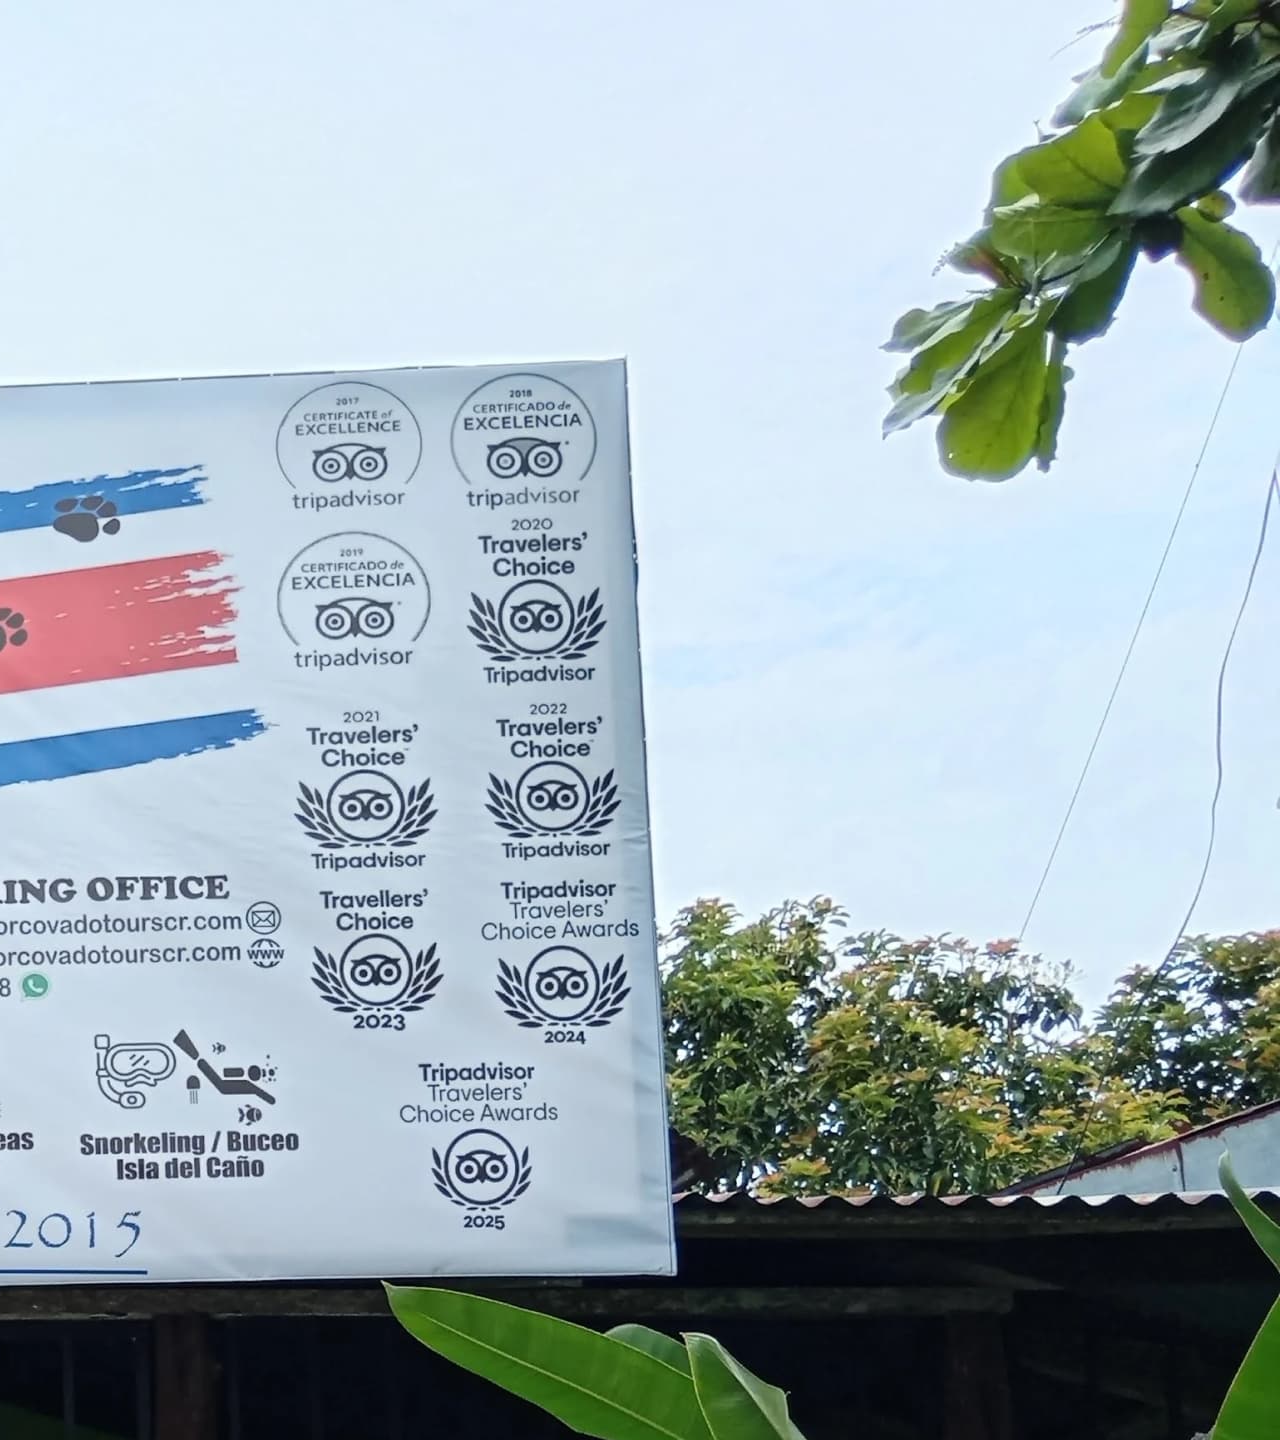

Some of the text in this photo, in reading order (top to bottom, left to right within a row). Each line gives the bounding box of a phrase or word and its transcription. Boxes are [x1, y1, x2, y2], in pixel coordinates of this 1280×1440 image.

[303, 409, 379, 422] CERTIFICATE
[472, 402, 555, 414] CERTIFICADO
[294, 419, 401, 436] EXCELLENCE
[463, 413, 583, 431] EXCELENCIA
[293, 489, 406, 512] tripadvisor
[466, 486, 580, 510] tripadvisor
[511, 518, 553, 531] 2020
[300, 560, 388, 573] CERTIFICADO
[492, 556, 575, 578] Choice
[291, 572, 416, 590] EXCELENCIA
[294, 647, 413, 671] tripadvisor
[483, 664, 595, 686] Tripadvisor
[343, 711, 380, 723] 2021
[529, 703, 568, 715] 2022
[321, 748, 406, 768] Choice
[510, 740, 591, 758] Choice
[501, 841, 611, 861] Tripadvisor
[311, 853, 426, 872] Tripadvisor
[87, 874, 230, 902] OFFICE
[500, 880, 616, 901] Tripadvisor
[335, 911, 414, 932] Choice
[480, 920, 640, 941] Choice Awards
[353, 1014, 406, 1030] 2023
[544, 1031, 586, 1044] 2024
[418, 1062, 535, 1085] Tripadvisor
[399, 1102, 559, 1124] Choice Awards
[80, 1130, 299, 1156] Snorkeling Buceo
[116, 1155, 265, 1181] Isla del Caño
[4, 1208, 141, 1257] 2015
[463, 1215, 506, 1231] 2025
